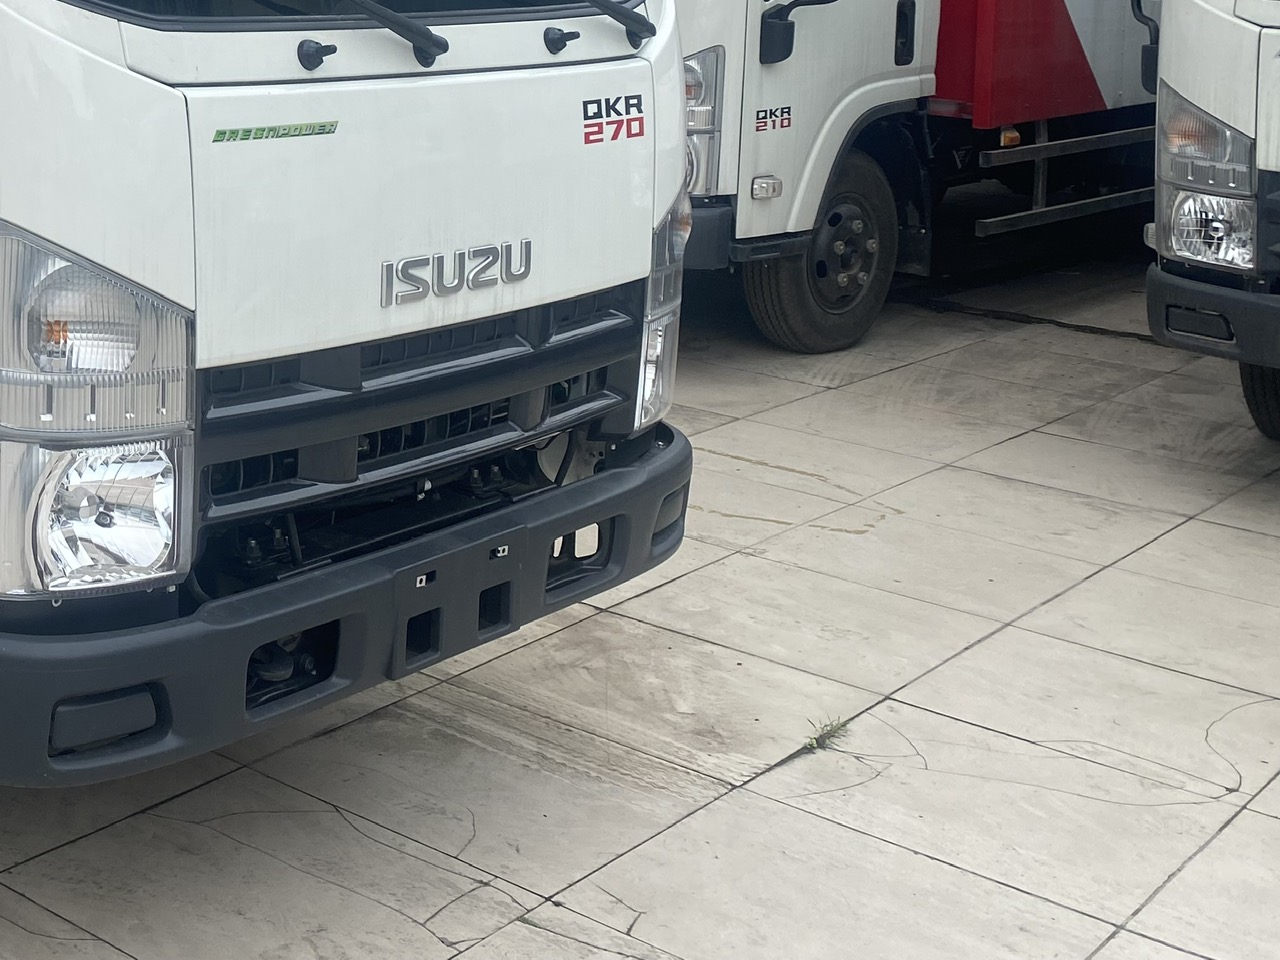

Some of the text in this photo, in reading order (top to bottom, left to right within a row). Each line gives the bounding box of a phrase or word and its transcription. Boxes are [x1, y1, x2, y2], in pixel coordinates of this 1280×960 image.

[582, 94, 644, 121] QKR
[756, 106, 791, 121] QKR
[583, 116, 645, 145] 270
[755, 117, 791, 132] 210
[380, 238, 532, 308] ISUZU
